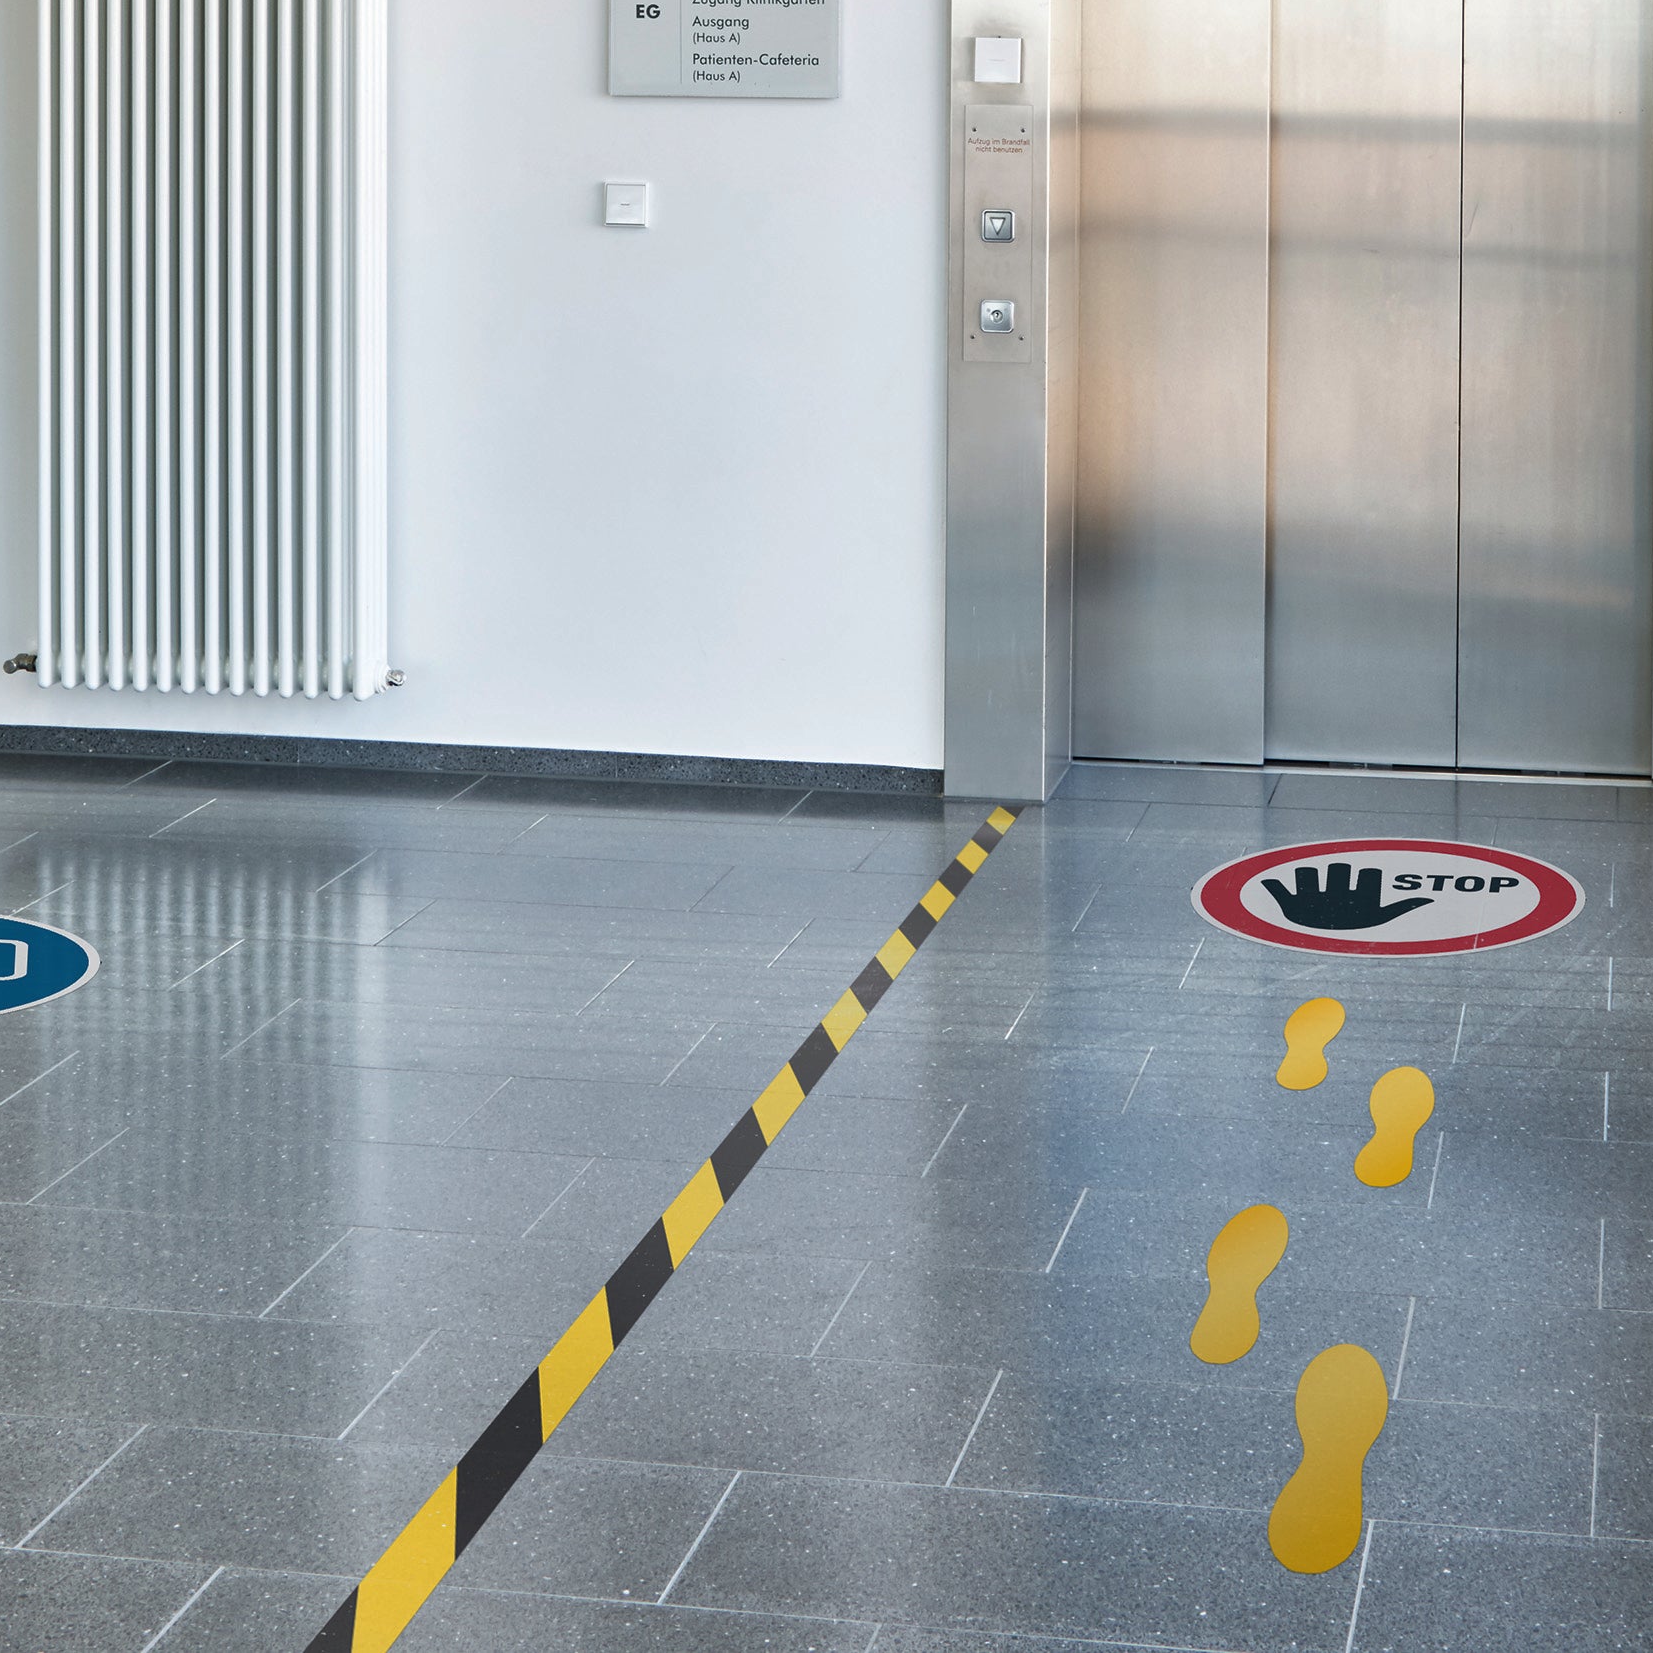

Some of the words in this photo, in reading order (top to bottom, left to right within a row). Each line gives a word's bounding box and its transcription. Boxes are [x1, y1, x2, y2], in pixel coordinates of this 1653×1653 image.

[635, 3, 661, 20] EG
[691, 15, 750, 31] Ausgang
[692, 32, 726, 45] (Haus
[728, 32, 741, 45] A)
[692, 52, 820, 67] Patienten-Cafeteria
[692, 70, 726, 83] (Haus
[728, 70, 741, 83] A)
[968, 138, 991, 146] Aufzug
[975, 145, 992, 153] nicht
[1392, 873, 1520, 894] STOP
